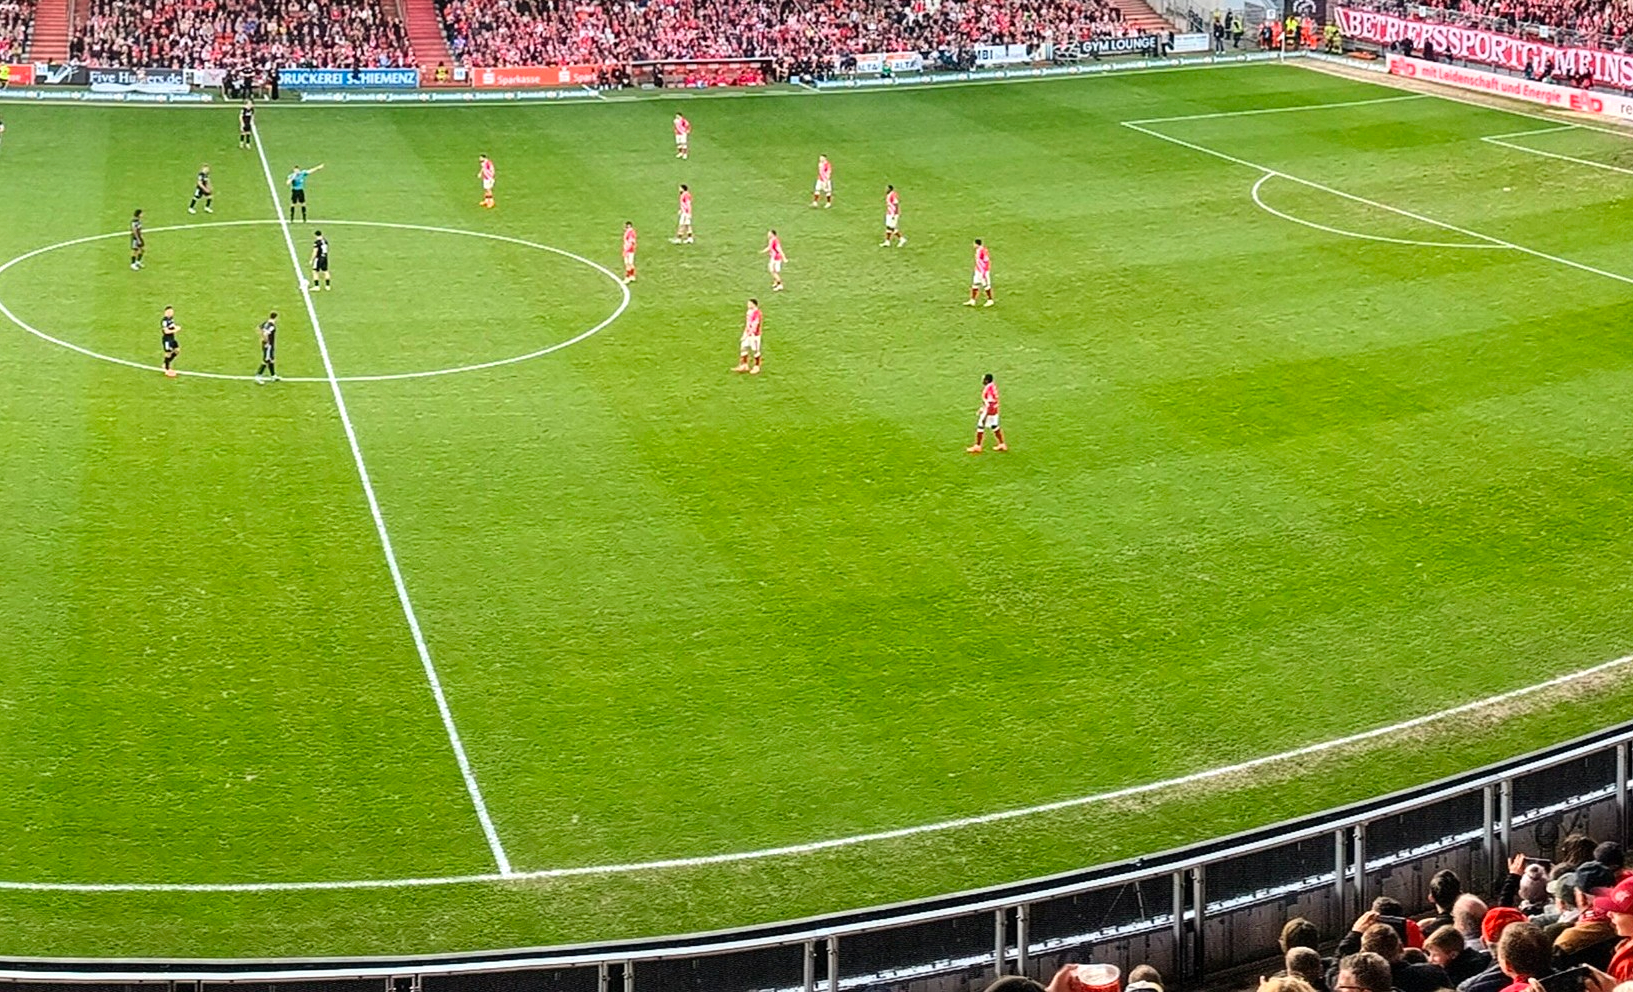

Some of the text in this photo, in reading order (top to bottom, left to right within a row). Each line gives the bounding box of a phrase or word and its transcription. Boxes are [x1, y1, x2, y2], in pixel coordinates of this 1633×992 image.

[1082, 36, 1157, 53] GYM LOUNGE
[89, 70, 117, 85] Five
[277, 70, 343, 85] DRUCKEREI
[497, 73, 541, 85] Sparkasse
[1421, 66, 1563, 104] mit Leidenschaft und Energie
